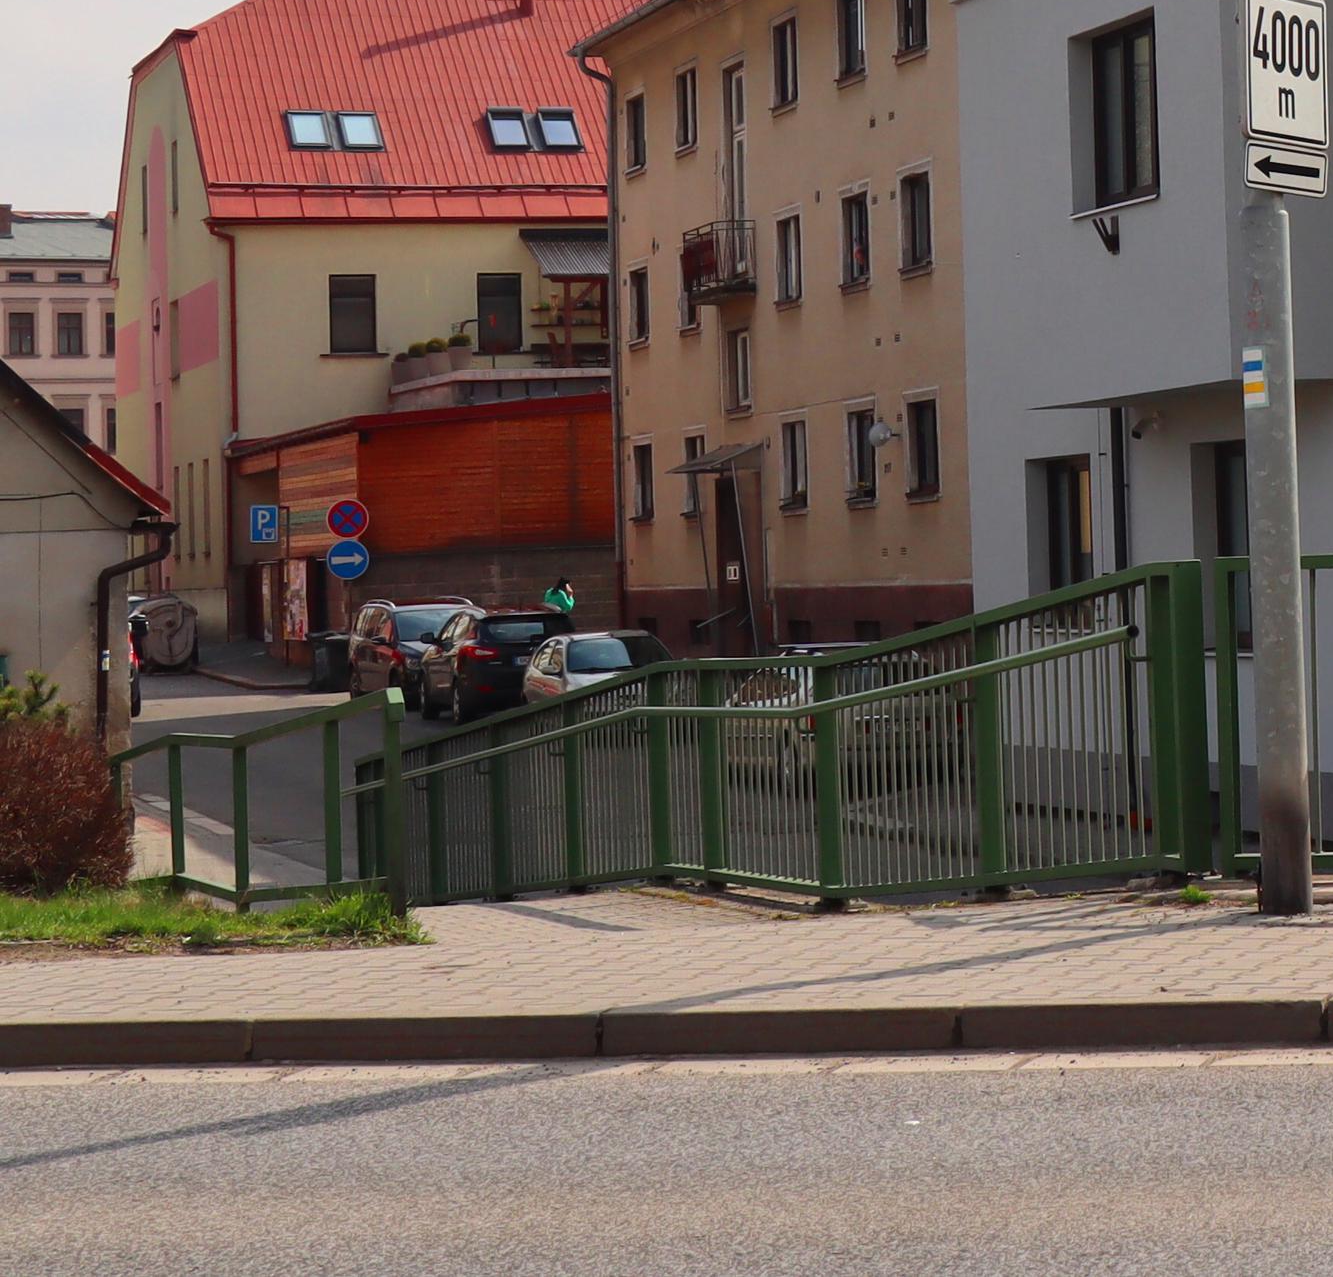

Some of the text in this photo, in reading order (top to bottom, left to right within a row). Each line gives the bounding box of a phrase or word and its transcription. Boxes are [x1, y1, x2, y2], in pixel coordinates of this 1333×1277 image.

[1252, 6, 1320, 81] 4000
[1278, 86, 1296, 120] m
[257, 510, 270, 530] P
